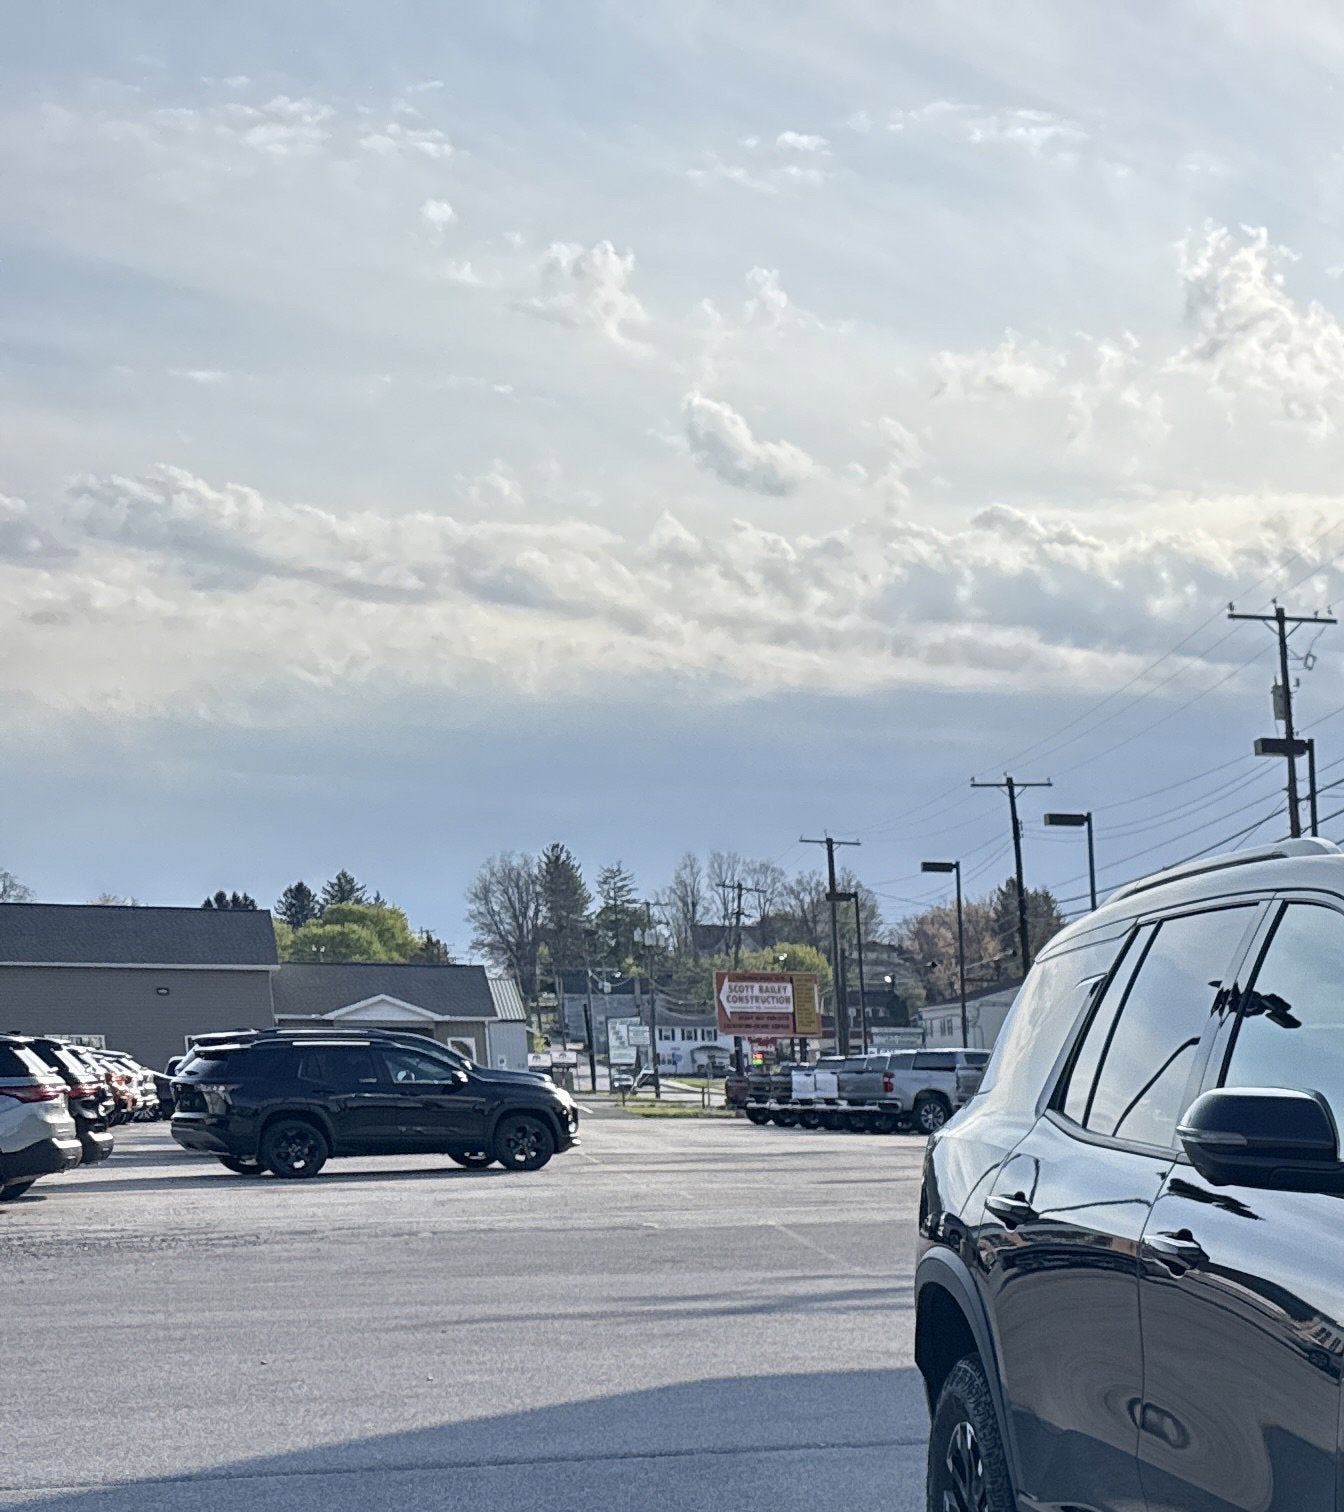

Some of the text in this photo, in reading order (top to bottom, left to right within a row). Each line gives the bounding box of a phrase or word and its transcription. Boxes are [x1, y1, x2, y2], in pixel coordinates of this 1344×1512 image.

[728, 984, 788, 995] SCOTT BAILEY
[726, 995, 791, 1006] CONSTRUCTION
